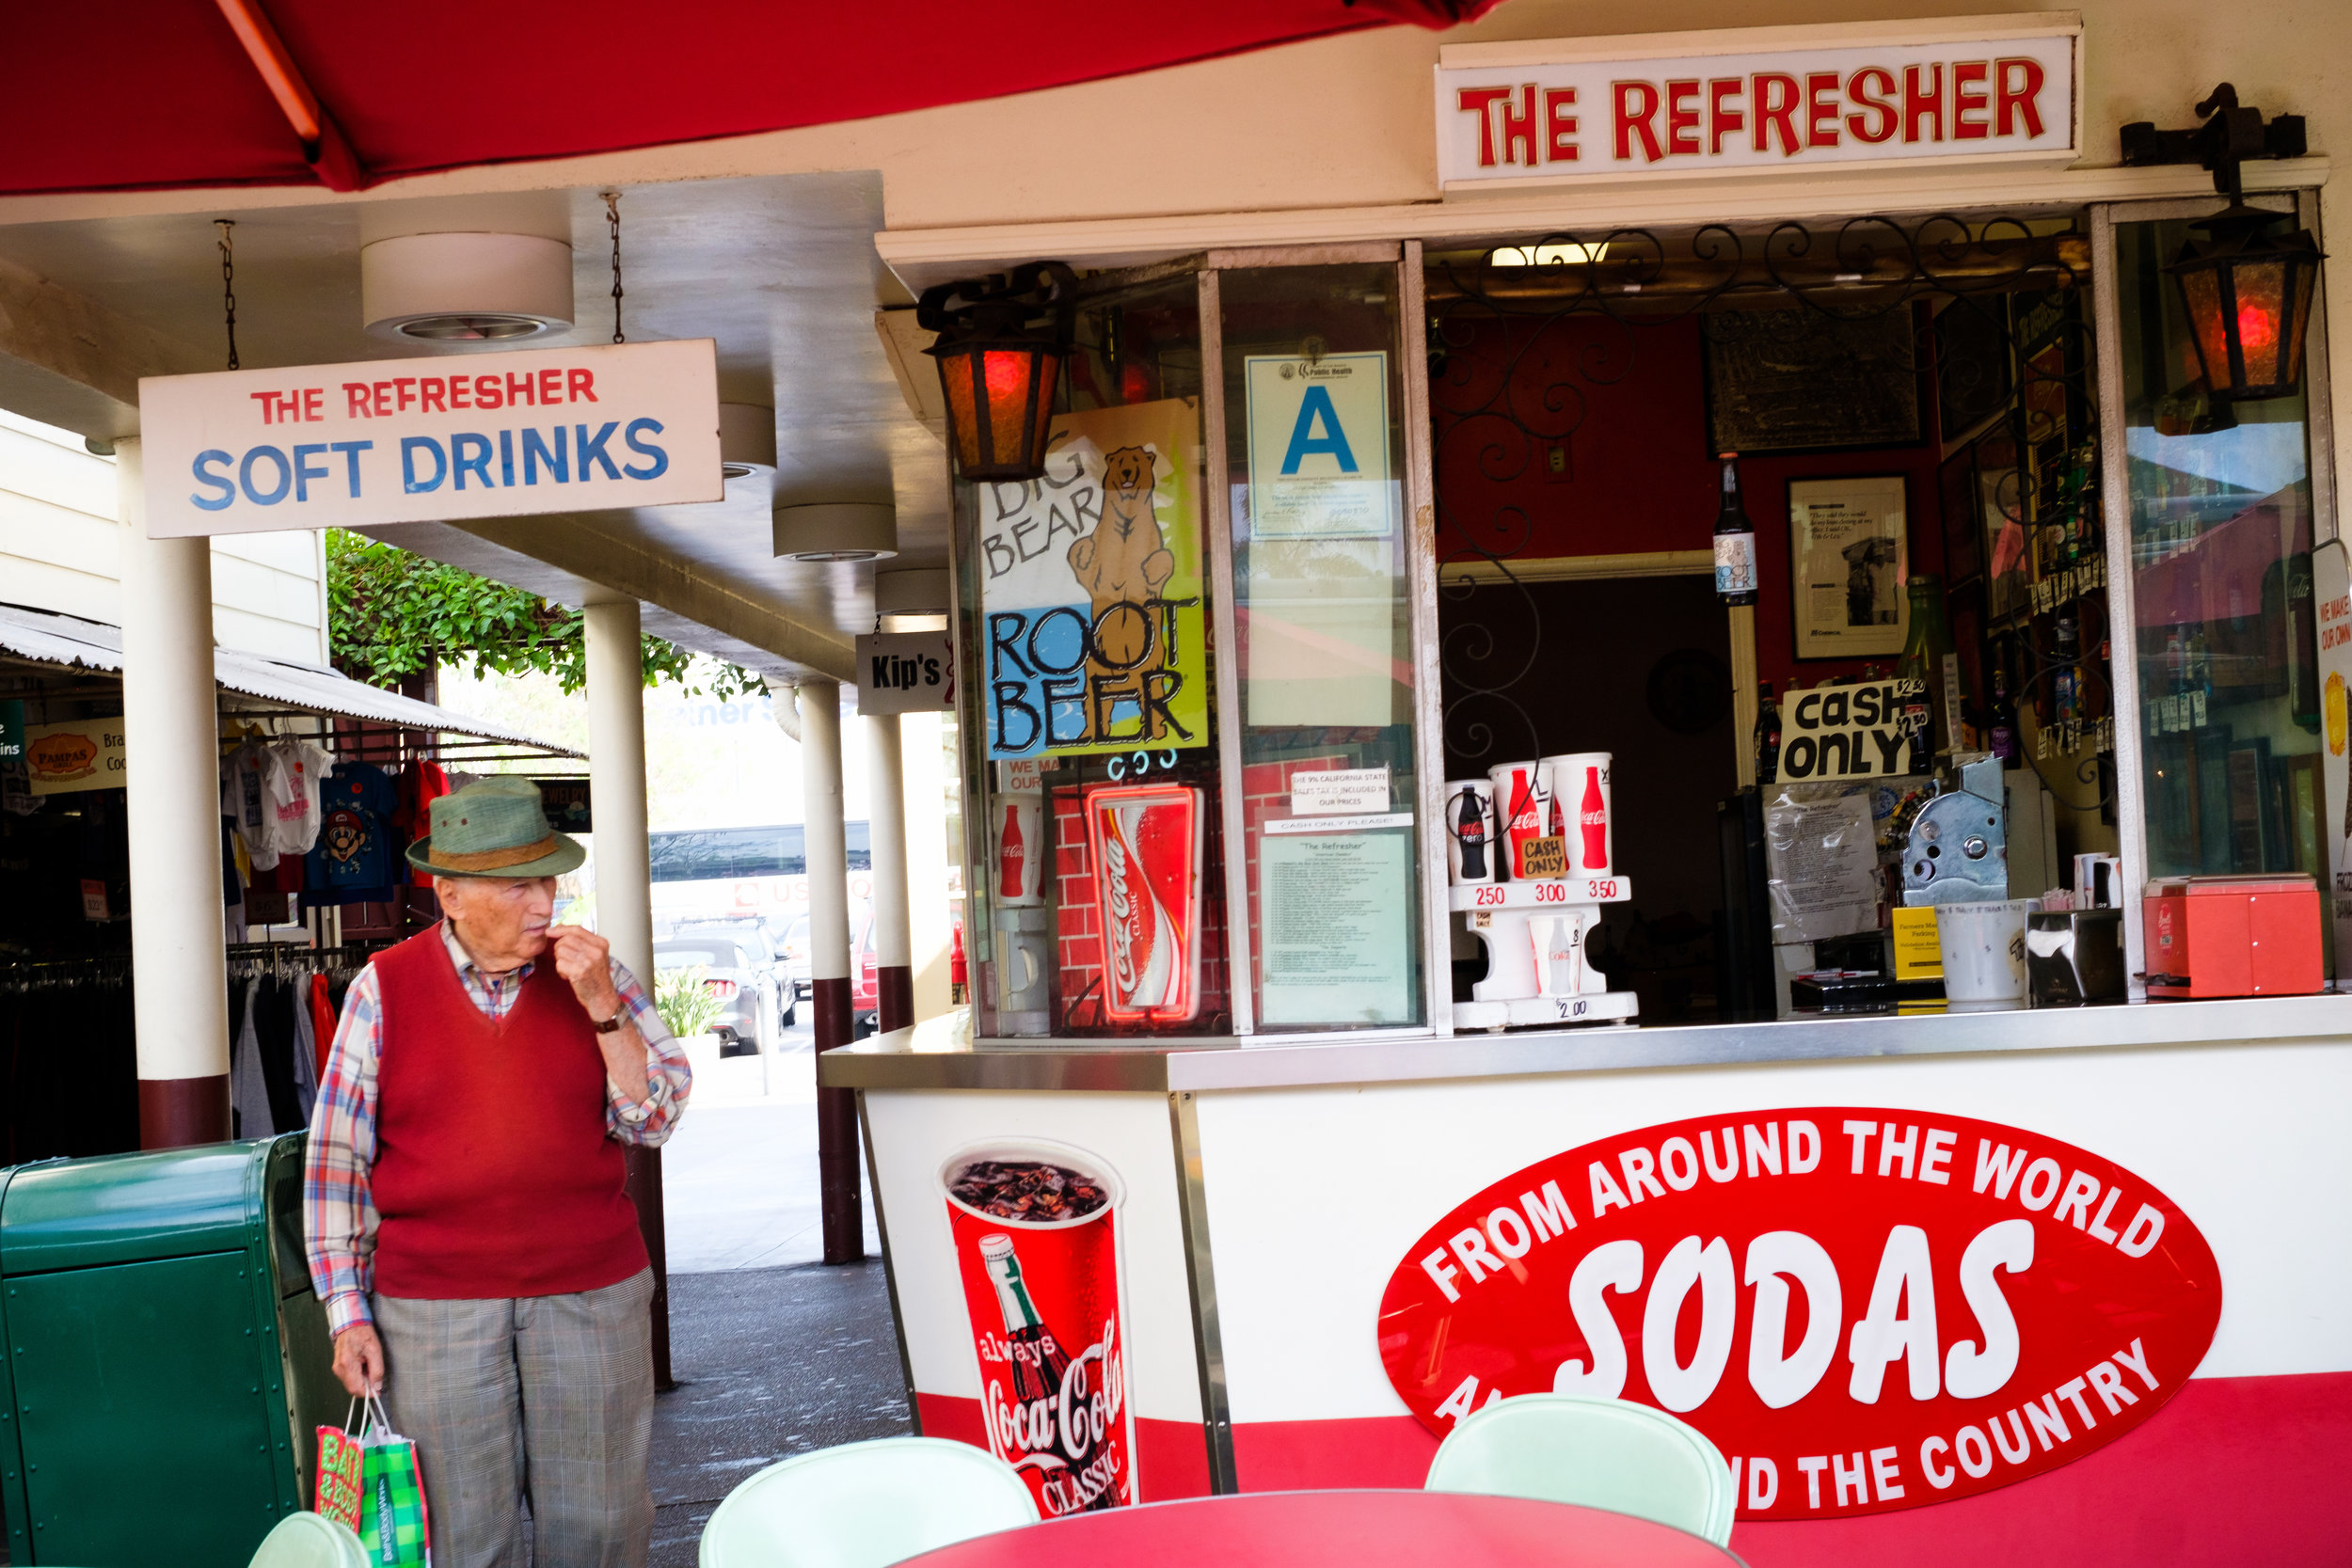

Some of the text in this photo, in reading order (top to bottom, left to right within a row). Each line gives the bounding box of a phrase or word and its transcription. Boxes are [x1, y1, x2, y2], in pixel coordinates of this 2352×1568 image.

[1457, 56, 2046, 168] THE REFRESHER
[250, 368, 599, 425] THE REFRESHER
[1279, 386, 1359, 475] A
[188, 417, 670, 512] SOFT DRINKS
[982, 486, 1101, 579] BEAR
[989, 597, 1201, 681] ROOT
[872, 653, 941, 690] Kip's
[992, 669, 1196, 753] BEER
[39, 748, 88, 764] PAMPAS
[1009, 760, 1032, 773] WE
[1320, 773, 1363, 783] CALIFORNIA
[1319, 798, 1361, 806] OUR PRICES
[1340, 784, 1376, 794] INCLUDED
[1280, 821, 1312, 830] CASH
[1314, 819, 1344, 829] ONLY
[1524, 839, 1562, 860] CASH
[1525, 855, 1564, 875] ONLY
[1132, 891, 1142, 937] CLASSIC
[1419, 1118, 2166, 1305] FROM AROUND THE WORLD
[1553, 1219, 2035, 1413] SODAS
[980, 1331, 1057, 1368] always
[988, 1308, 1124, 1471] Coca-Cola
[1800, 1446, 1905, 1511] THE
[1920, 1337, 2161, 1492] COUNTRY
[1041, 1440, 1121, 1517] CLASSIC
